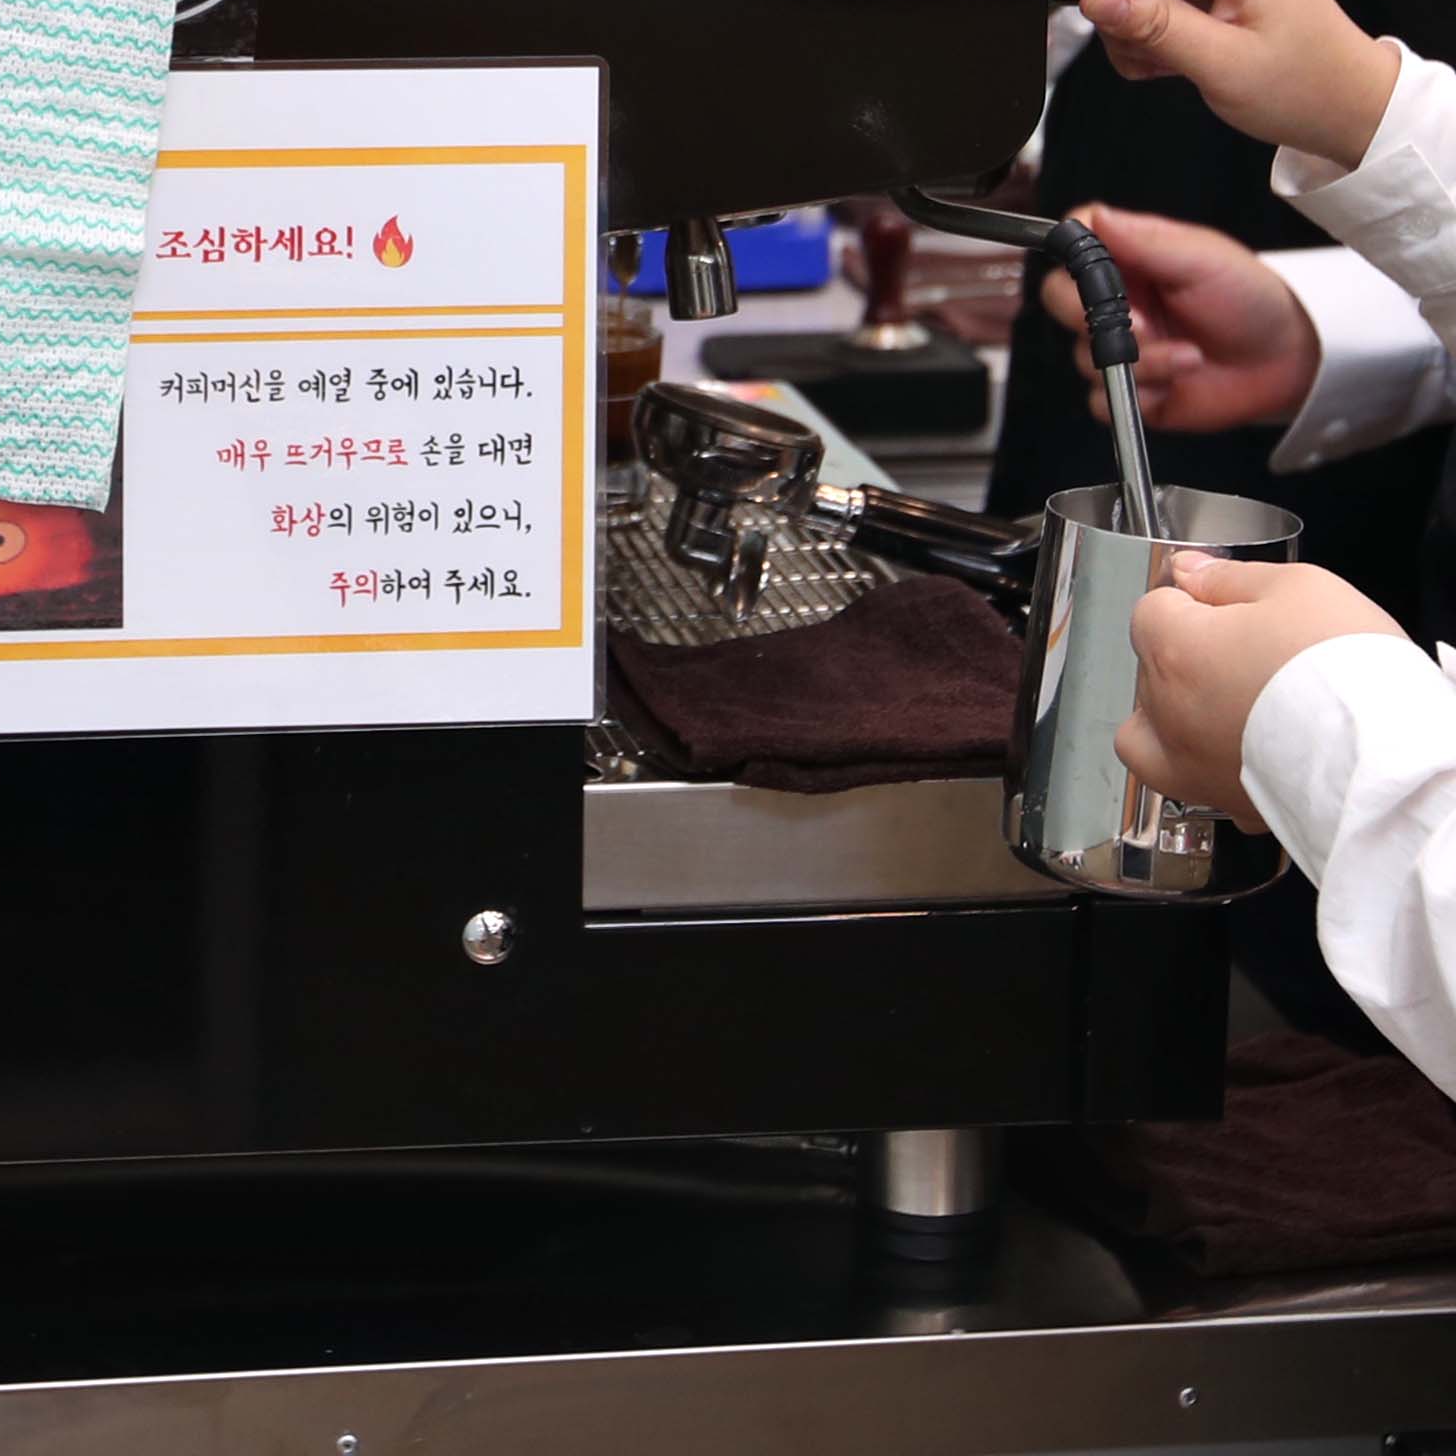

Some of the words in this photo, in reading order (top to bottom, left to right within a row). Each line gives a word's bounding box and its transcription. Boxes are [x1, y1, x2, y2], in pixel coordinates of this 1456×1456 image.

[155, 225, 353, 264] 조심하세요!
[159, 368, 286, 404] 커피머신을
[297, 366, 352, 403] 예열
[365, 367, 419, 402] 중에
[432, 365, 533, 401] 있습니다.
[216, 438, 272, 471] 매우
[285, 437, 409, 469] 뜨거우므로
[420, 432, 465, 467] 손을
[477, 432, 532, 466] 대면
[271, 502, 353, 538] 화상의
[365, 499, 439, 535] 위험이
[452, 498, 532, 534] 있으니,
[329, 568, 431, 607] 주의하여
[444, 567, 531, 605] 주세요.
